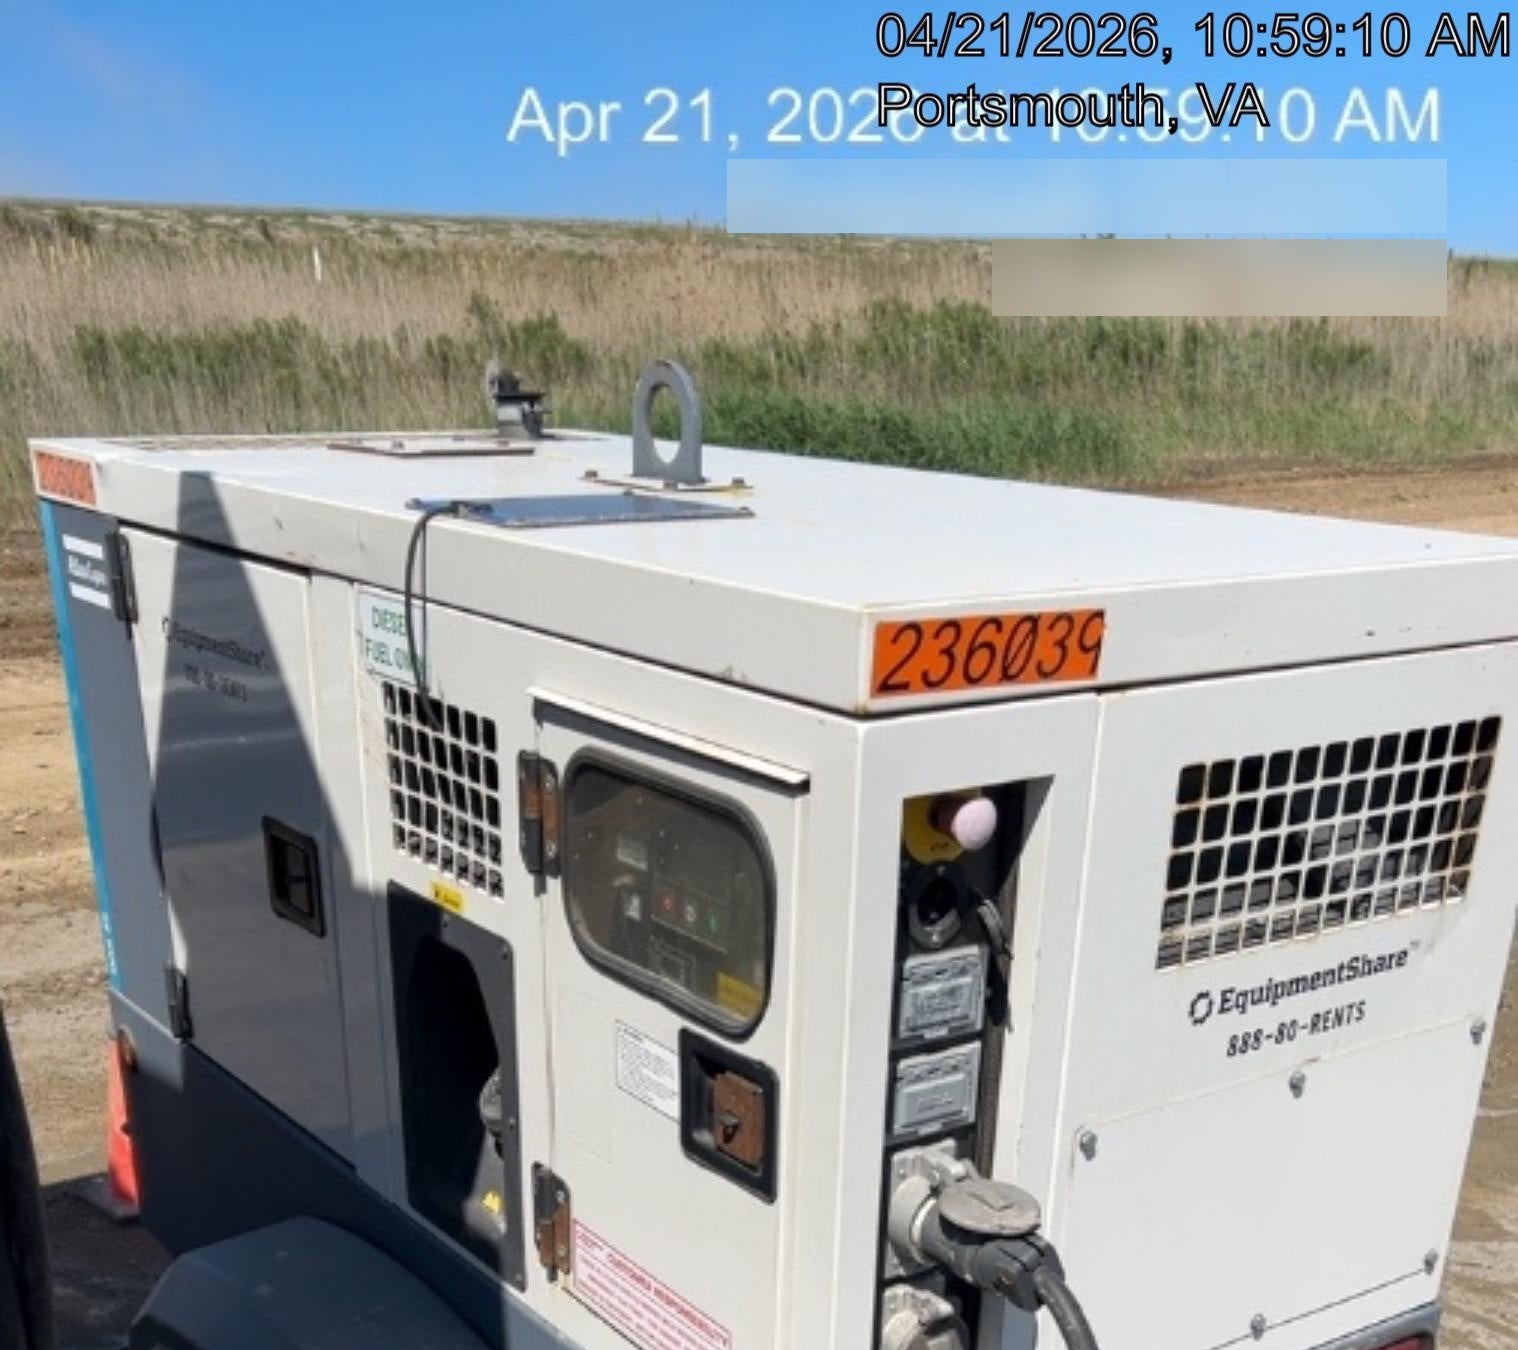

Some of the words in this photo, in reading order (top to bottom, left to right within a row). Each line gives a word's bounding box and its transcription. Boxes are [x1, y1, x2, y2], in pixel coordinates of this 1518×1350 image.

[876, 611, 1106, 693] 236039
[1217, 948, 1409, 1015] EquipmentShare
[1226, 999, 1367, 1058] 888-80-RENTS
